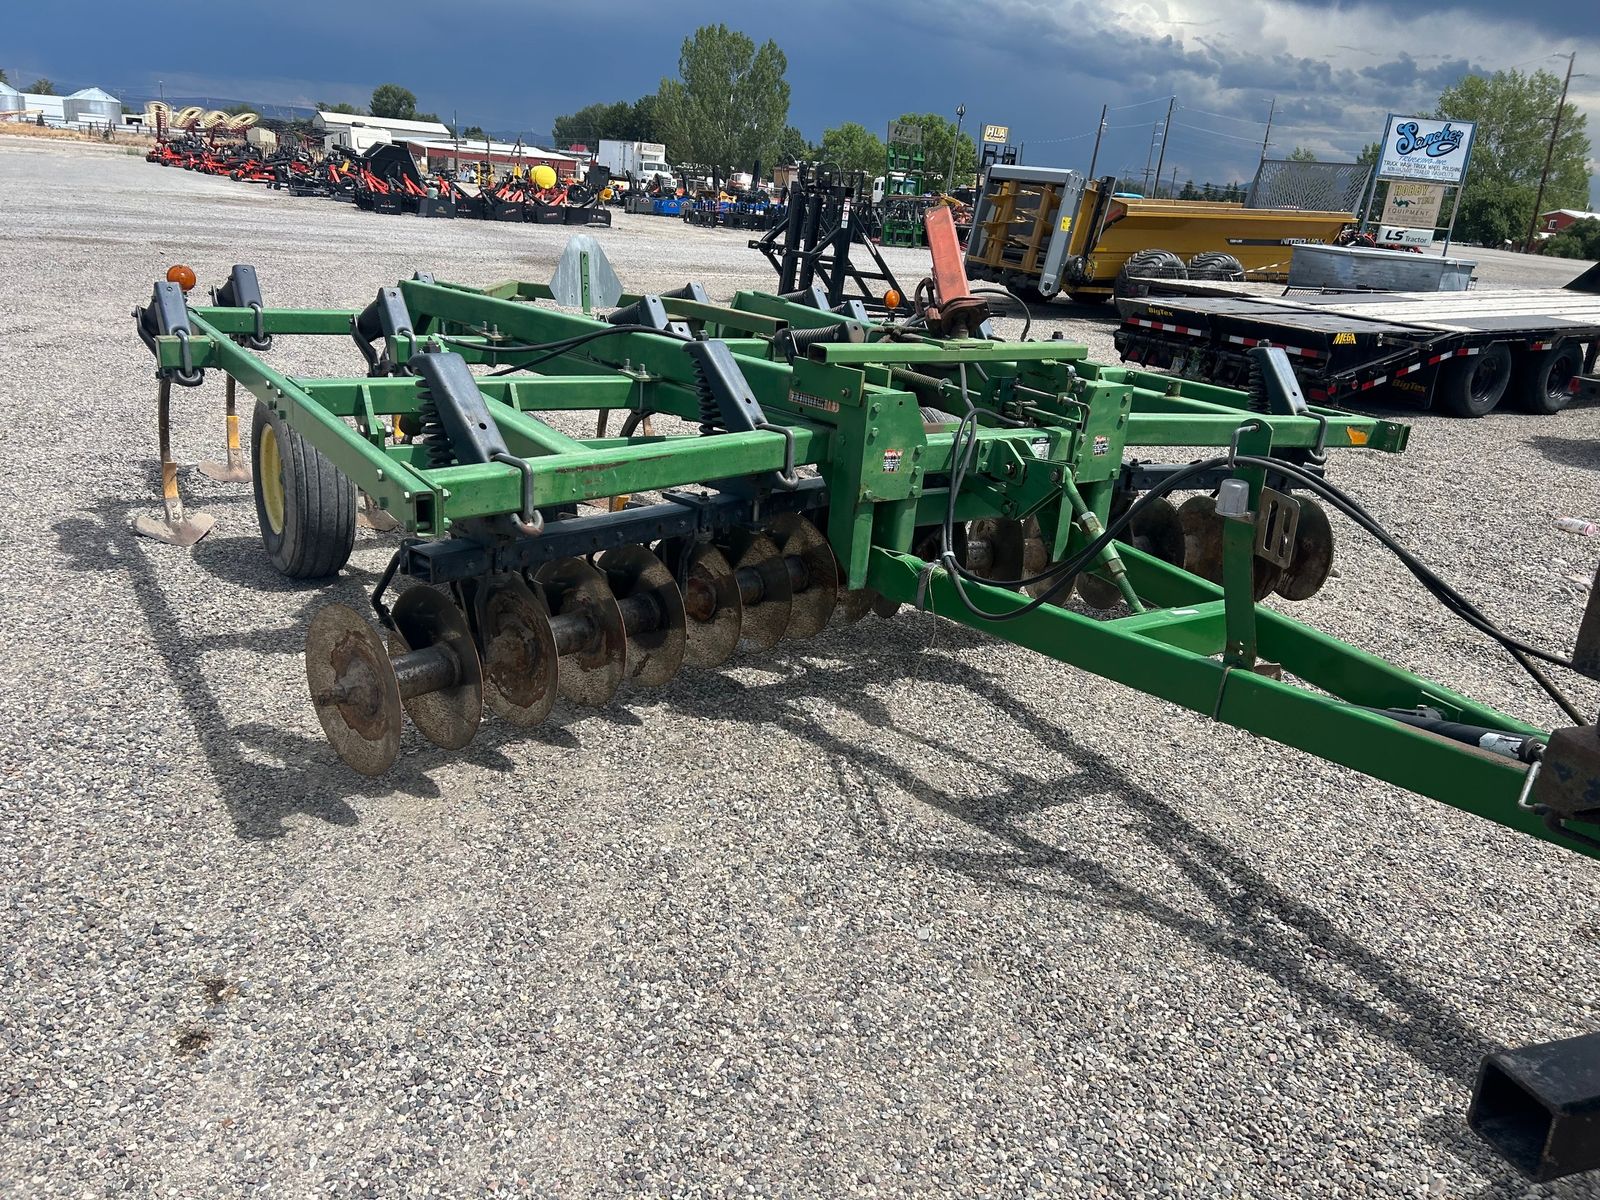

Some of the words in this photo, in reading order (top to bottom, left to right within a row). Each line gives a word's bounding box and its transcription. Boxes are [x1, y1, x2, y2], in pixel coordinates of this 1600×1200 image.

[987, 127, 1005, 138] HLA
[1396, 121, 1464, 157] Sanchez
[1394, 184, 1430, 196] HOBBY
[1387, 208, 1429, 216] EQUIPMENT
[1385, 230, 1405, 241] LS
[1405, 235, 1428, 243] Tractor
[1148, 307, 1174, 317] BigTex
[1332, 331, 1357, 344] MEGA
